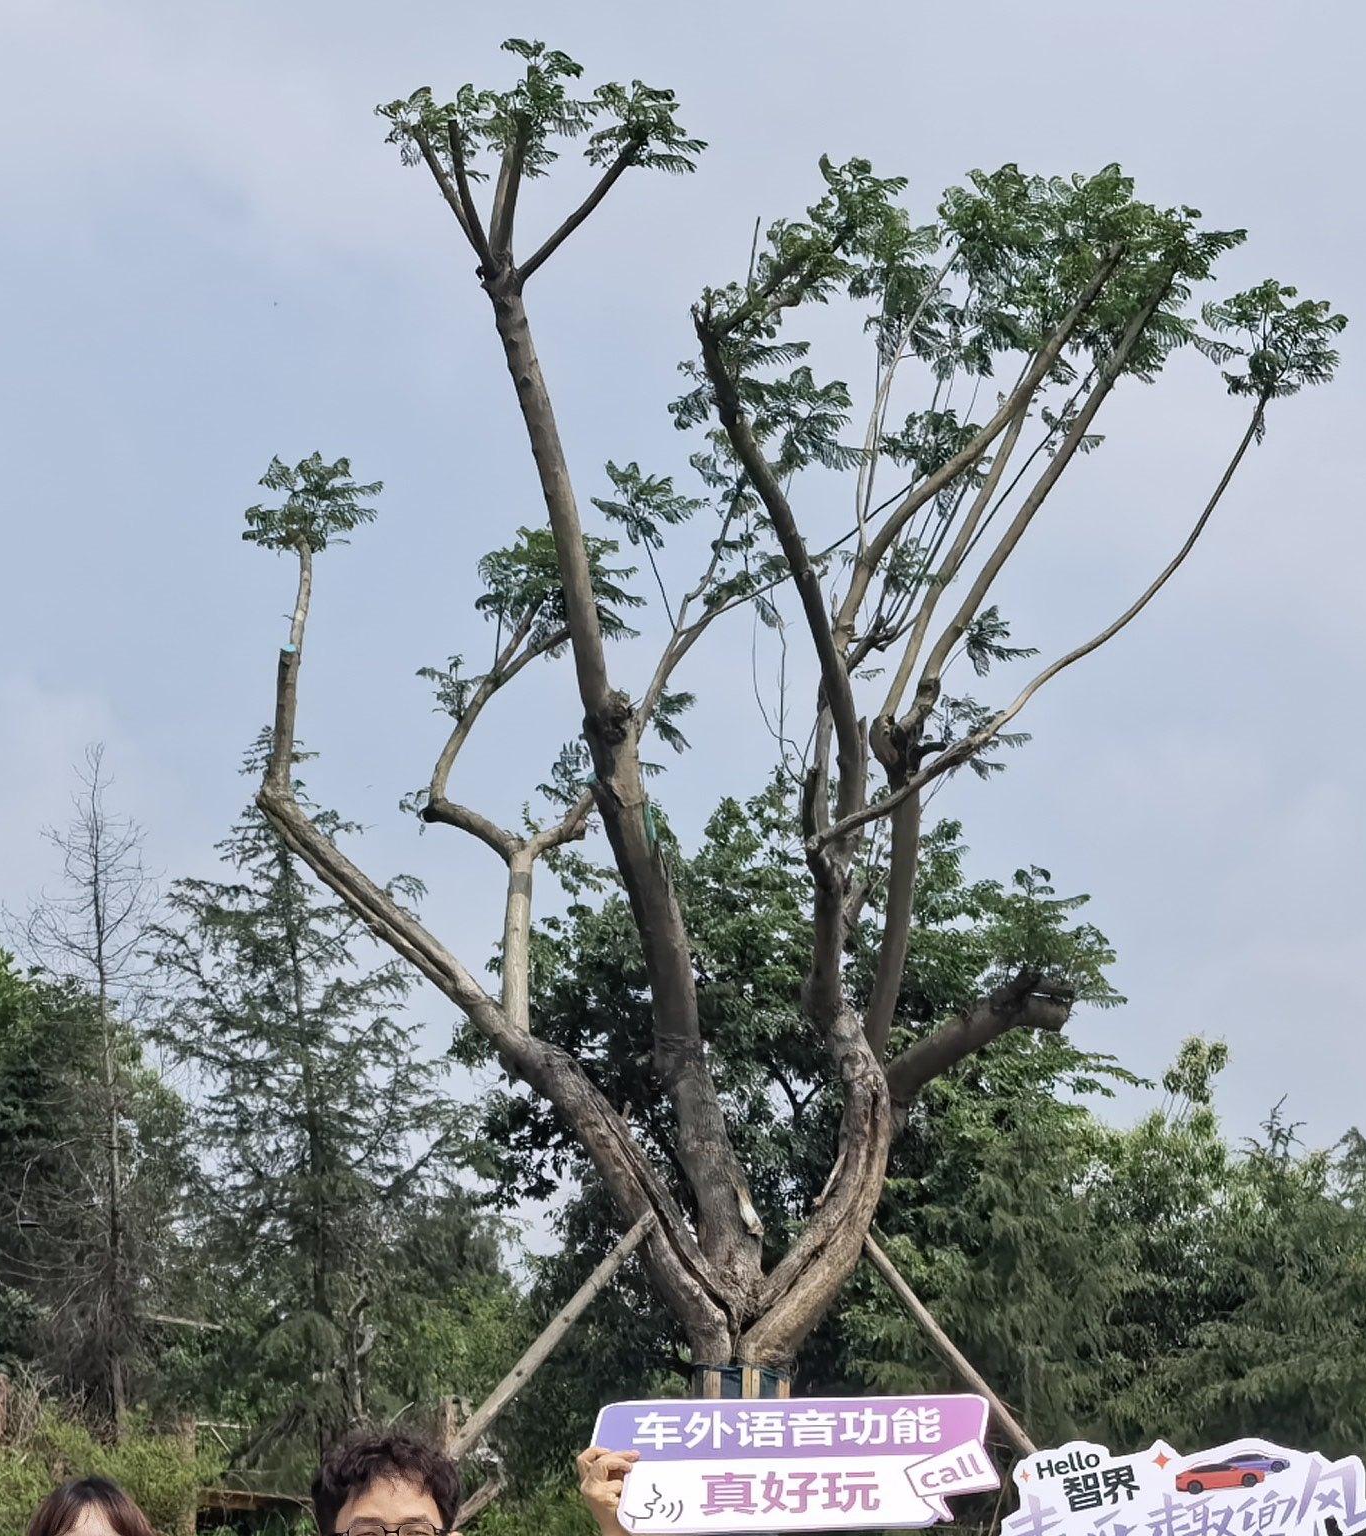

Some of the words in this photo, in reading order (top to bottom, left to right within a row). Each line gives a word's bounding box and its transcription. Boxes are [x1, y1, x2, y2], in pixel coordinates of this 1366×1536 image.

[632, 1407, 942, 1450] 车外语音功能
[919, 1453, 985, 1490] call
[1036, 1451, 1100, 1480] Hello
[700, 1471, 881, 1516] 真好玩
[1063, 1464, 1140, 1512] 智界
